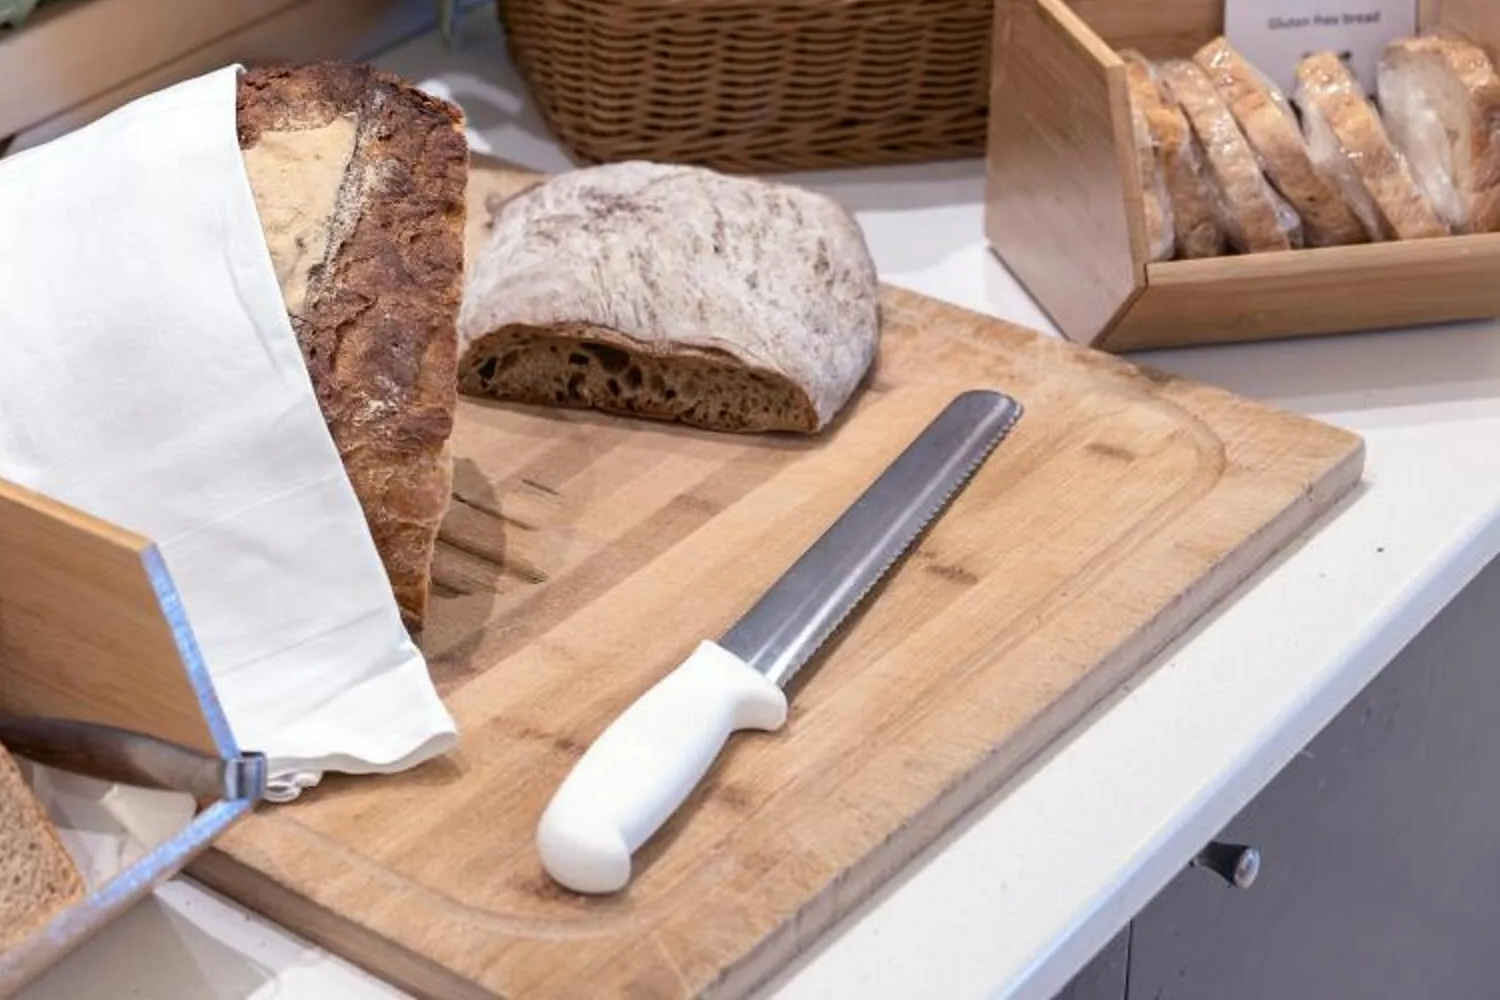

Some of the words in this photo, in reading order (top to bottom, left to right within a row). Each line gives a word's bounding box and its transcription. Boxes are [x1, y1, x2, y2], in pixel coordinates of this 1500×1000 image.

[1268, 16, 1310, 31] Gluten
[1313, 13, 1339, 26] free
[1342, 11, 1381, 25] bread
